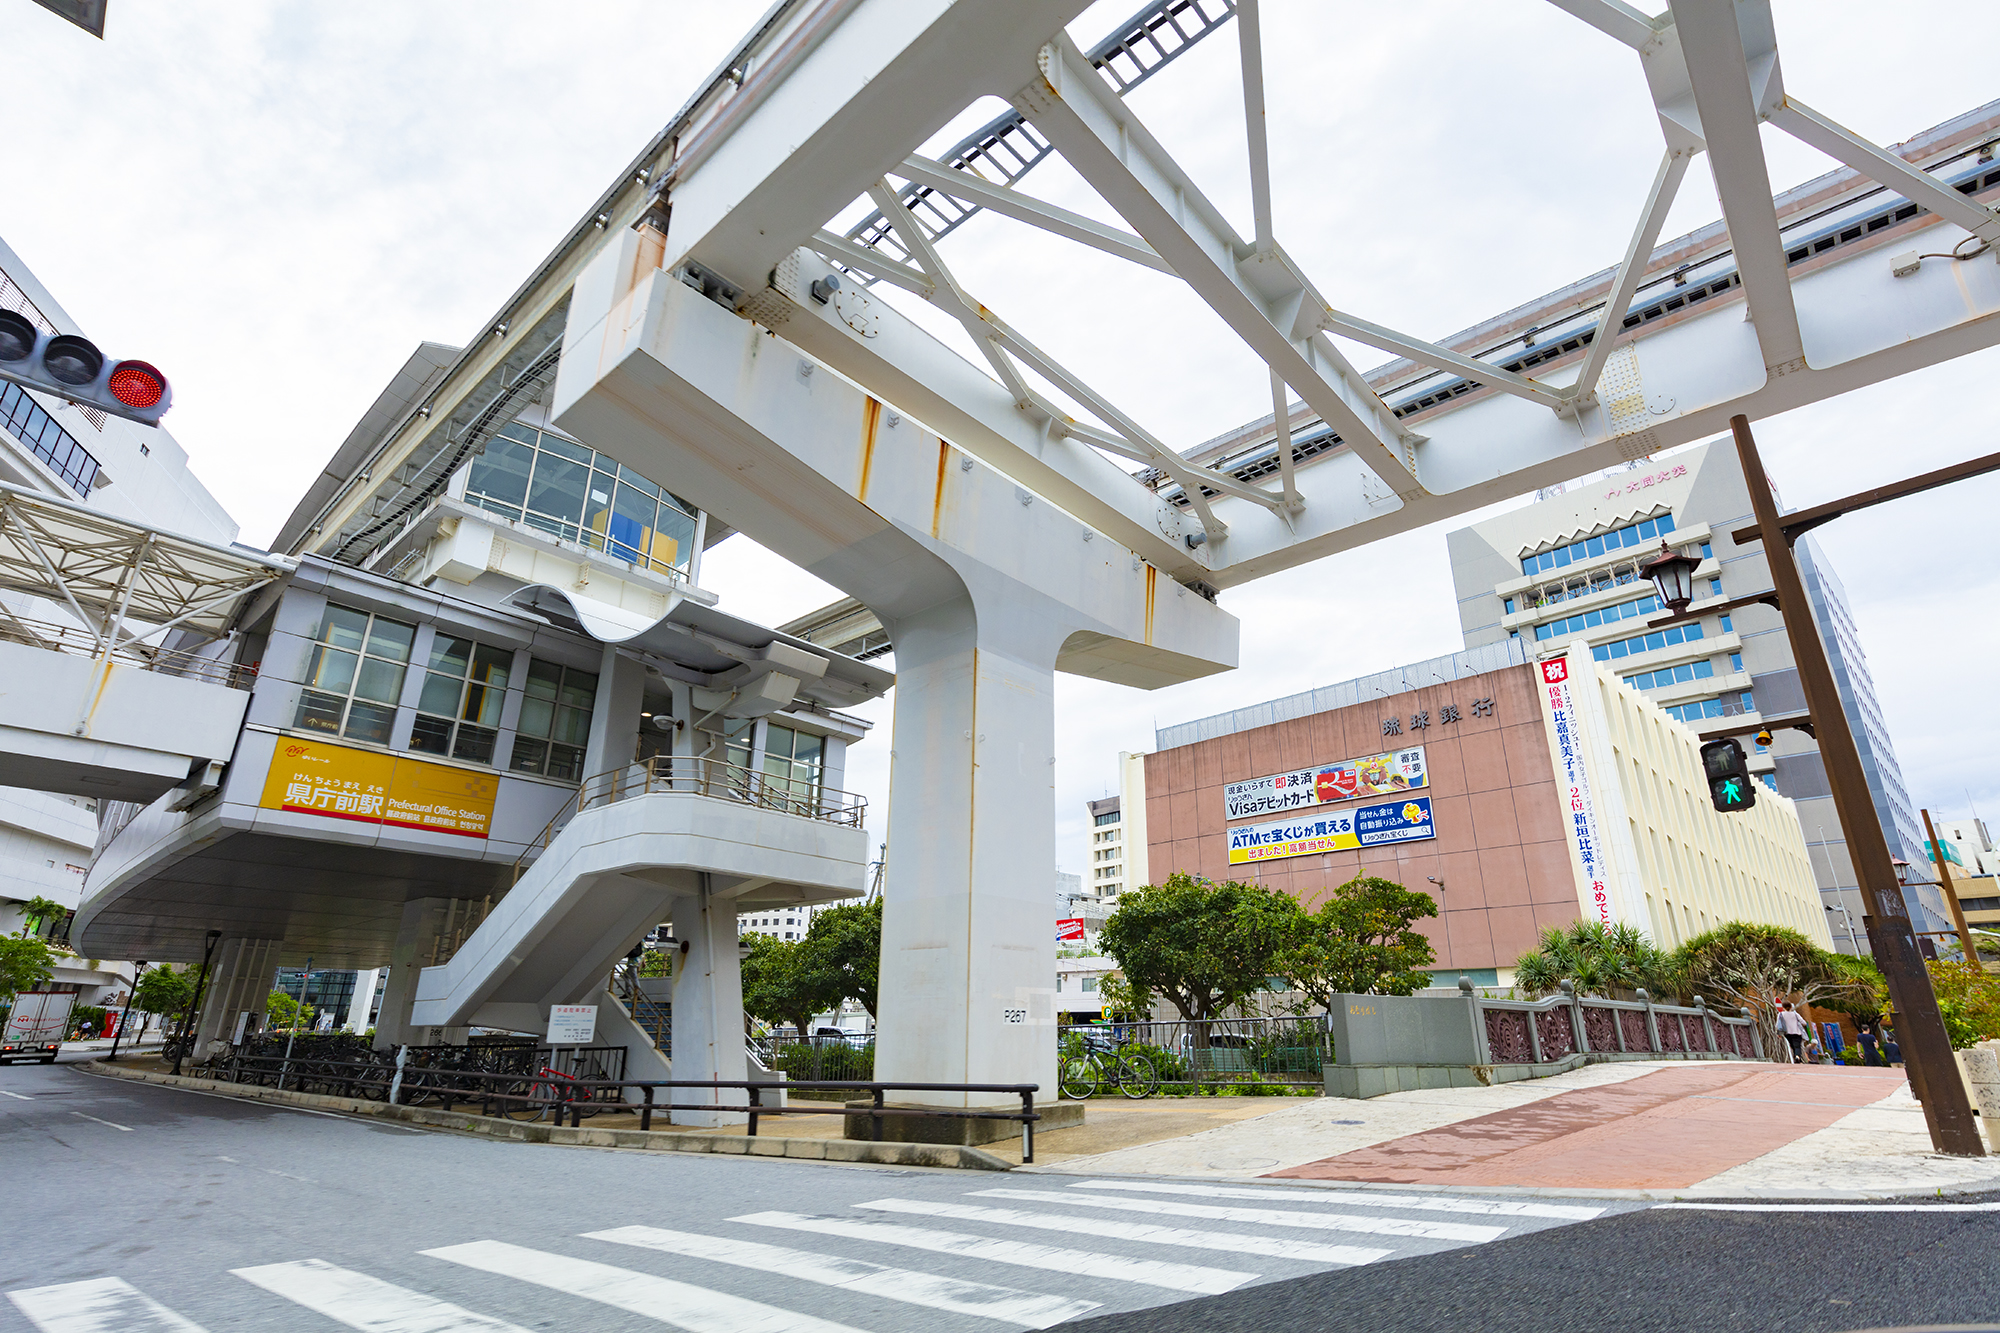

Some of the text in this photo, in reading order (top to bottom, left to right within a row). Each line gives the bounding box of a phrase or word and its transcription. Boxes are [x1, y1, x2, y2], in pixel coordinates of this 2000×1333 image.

[1626, 464, 1687, 493] 大同火災
[1545, 662, 1564, 680] 祝
[1382, 697, 1495, 736] 琉球銀行
[284, 783, 384, 815] 県庁前駅
[388, 798, 486, 821] Prefectural Office Station
[1360, 808, 1393, 819] 当せん金は
[1232, 819, 1351, 848] ATMで宝くじが買える
[1004, 1009, 1026, 1023] P267
